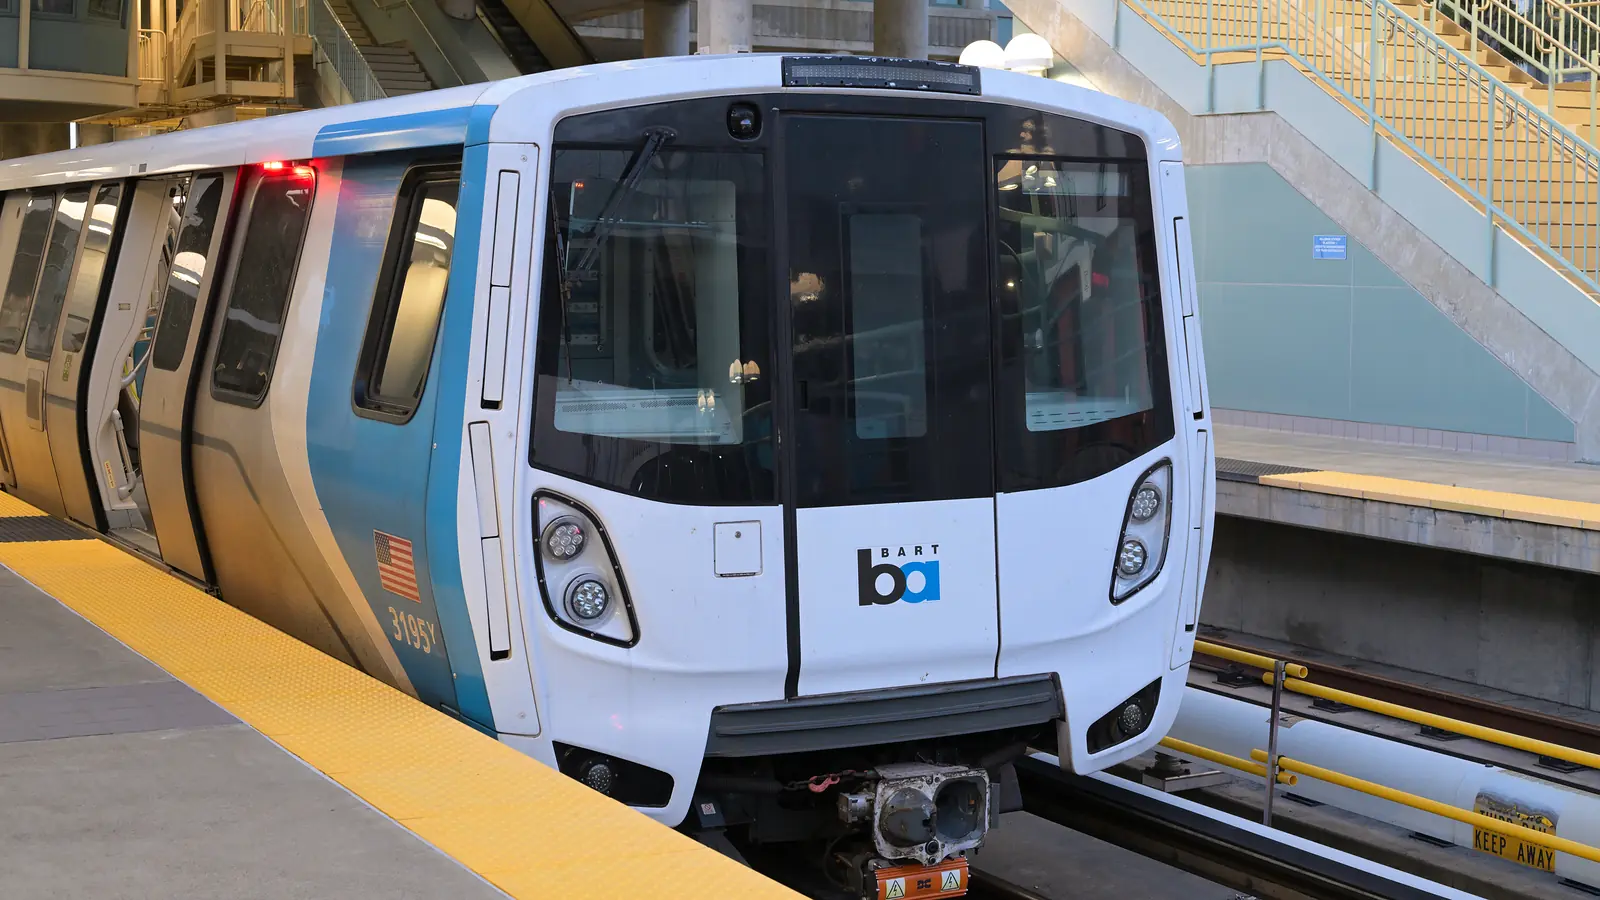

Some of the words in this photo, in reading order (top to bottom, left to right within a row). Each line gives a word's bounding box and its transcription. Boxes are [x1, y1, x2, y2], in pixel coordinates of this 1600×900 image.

[881, 544, 939, 558] BART
[1475, 829, 1506, 855] KEEP
[1517, 842, 1553, 871] AWAY
